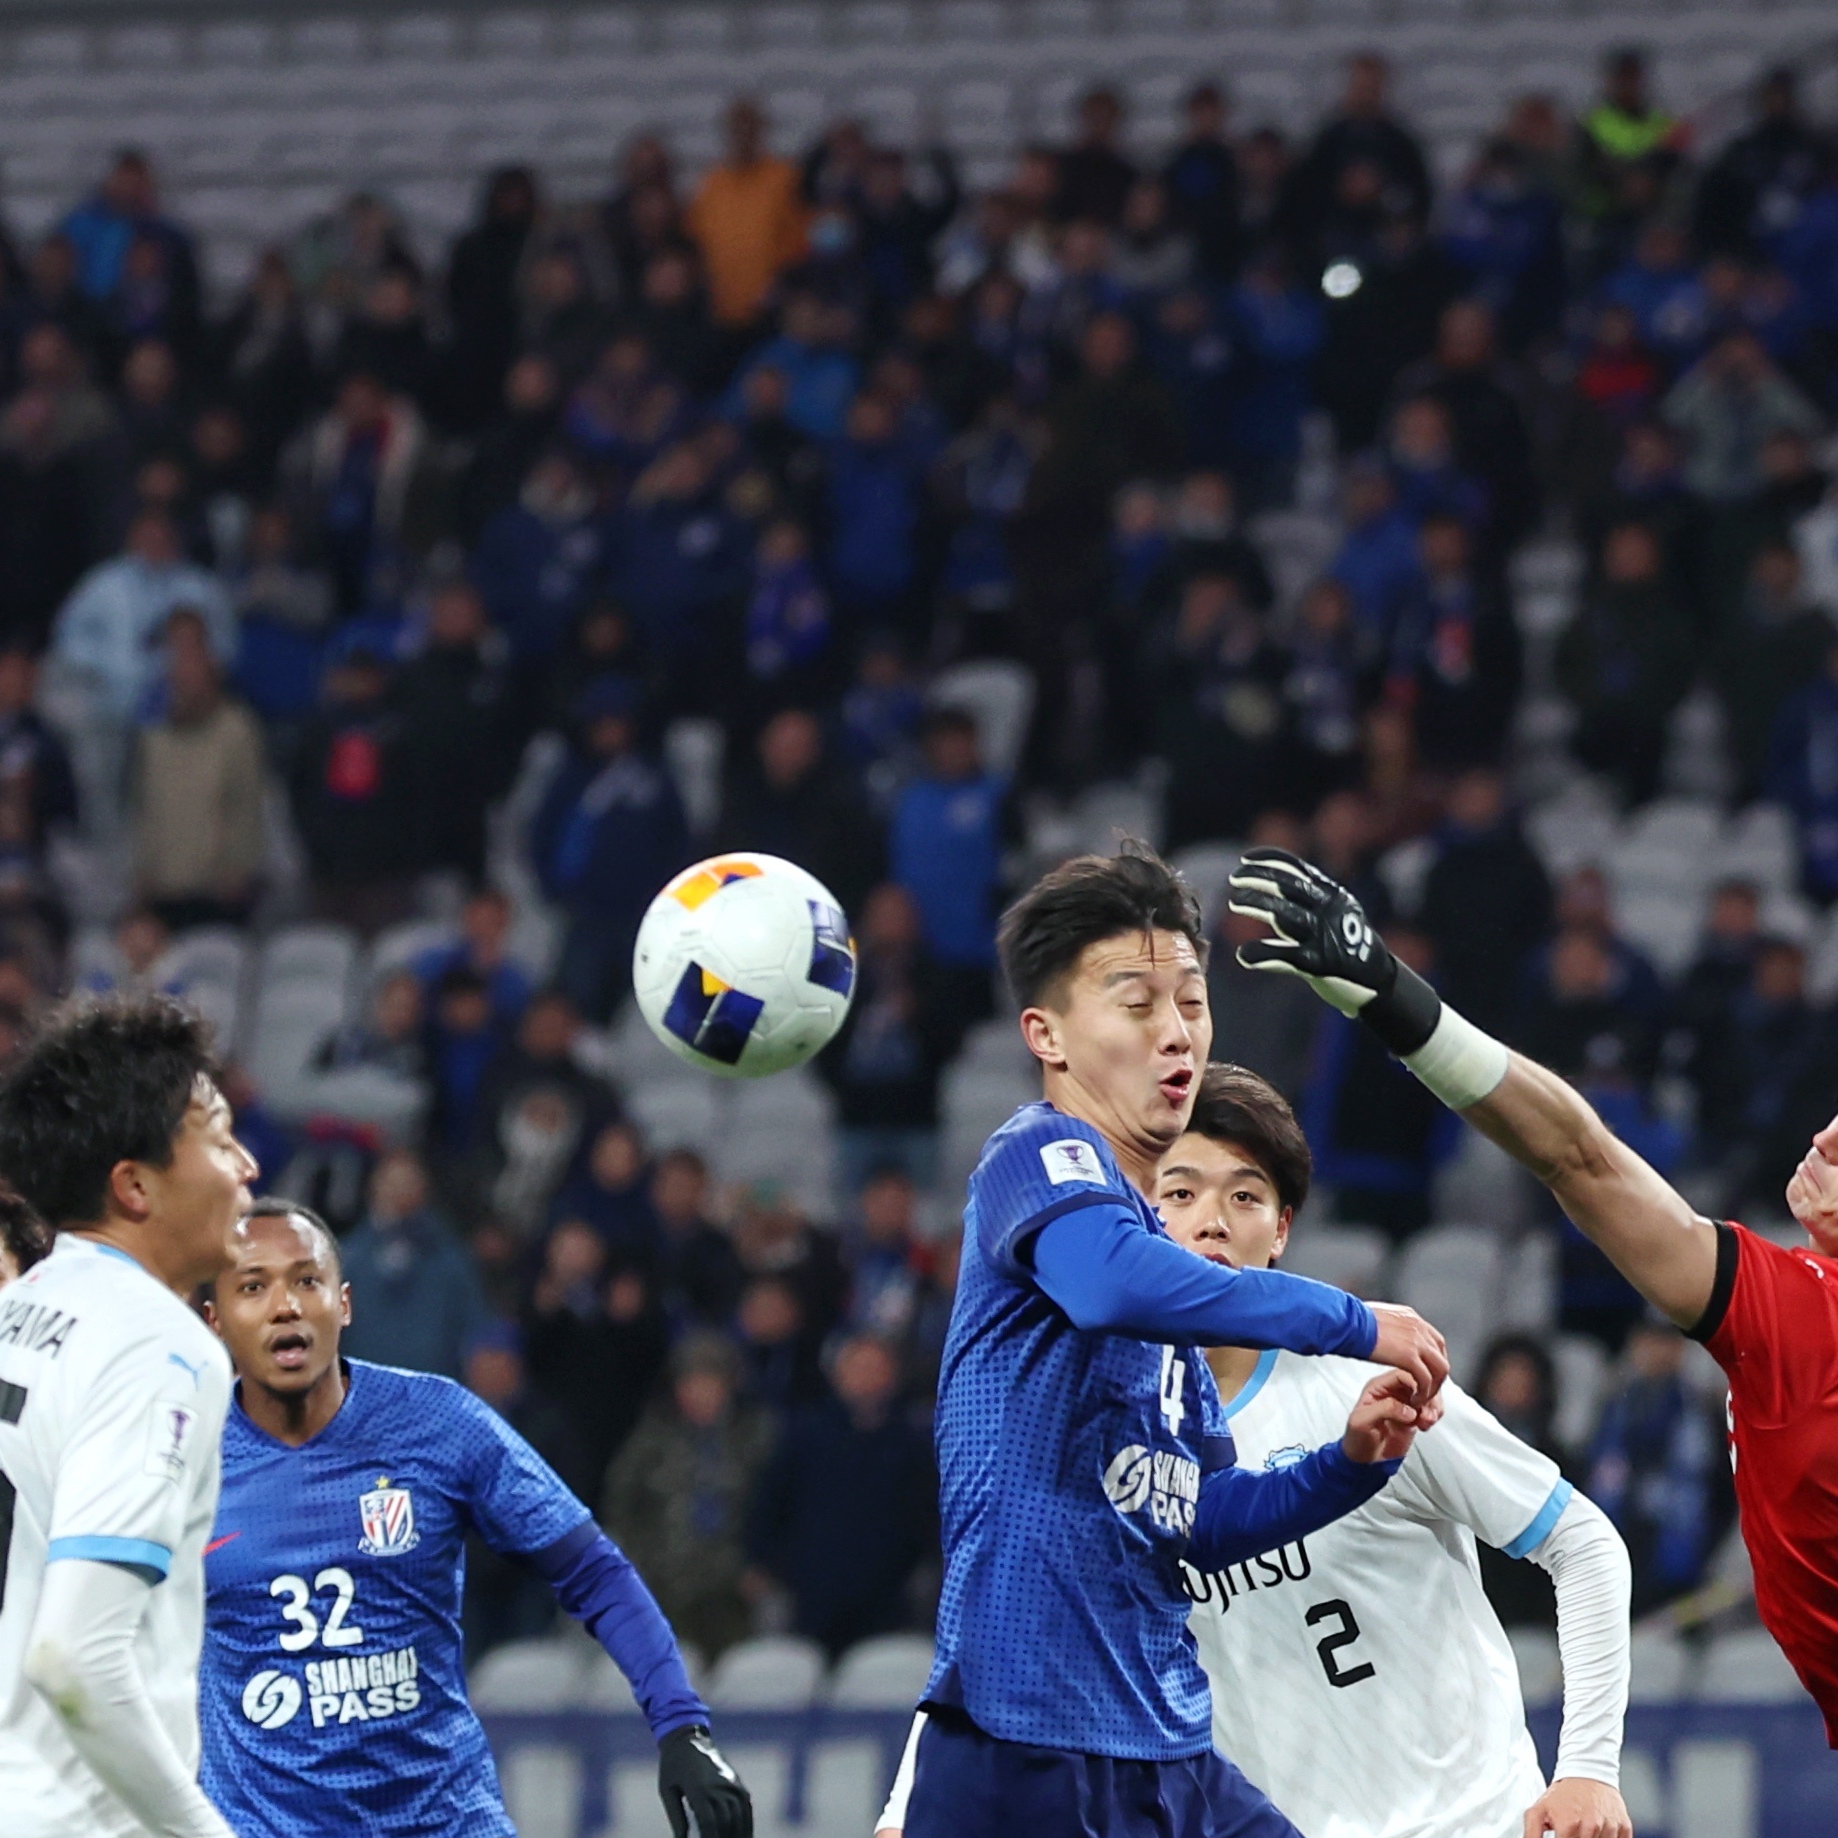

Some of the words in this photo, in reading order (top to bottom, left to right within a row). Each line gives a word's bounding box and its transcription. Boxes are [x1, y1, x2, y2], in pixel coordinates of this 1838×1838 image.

[1160, 1345, 1186, 1436] 4
[269, 1566, 364, 1652] 32
[1181, 1539, 1311, 1616] UJITSU
[304, 1645, 418, 1698] SHANGHAI
[1304, 1598, 1377, 1689] 2
[309, 1679, 421, 1728] PASS
